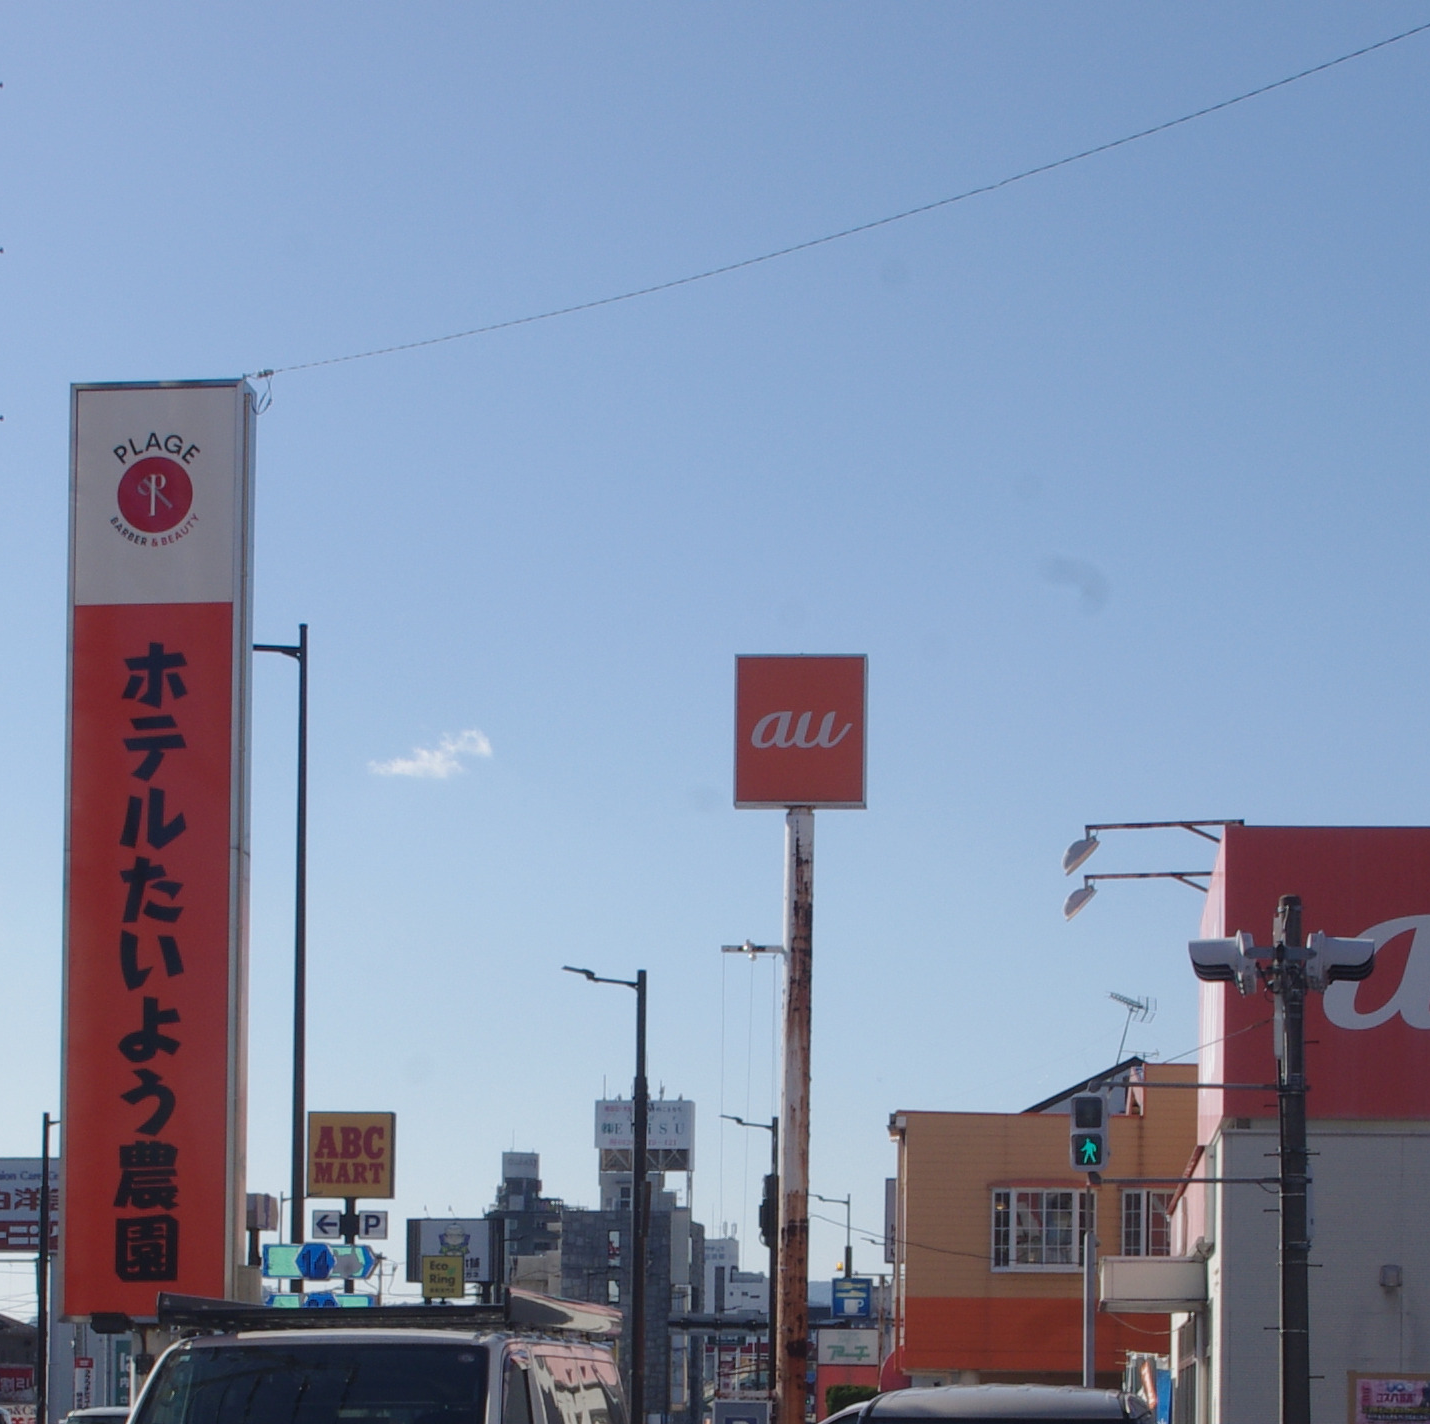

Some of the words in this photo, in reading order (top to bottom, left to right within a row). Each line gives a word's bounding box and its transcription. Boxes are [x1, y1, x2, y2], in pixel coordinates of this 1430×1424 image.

[112, 432, 201, 465] PLAGE
[109, 515, 148, 546] BARBER
[150, 537, 159, 547] &
[161, 512, 200, 546] BEAUTY
[751, 710, 854, 749] au
[113, 641, 189, 1283] ホテルたいよう農園
[313, 1126, 385, 1160] ABC
[313, 1161, 386, 1185] MART
[363, 1214, 381, 1236] P
[429, 1260, 449, 1271] Eco
[429, 1274, 456, 1287] Ring
